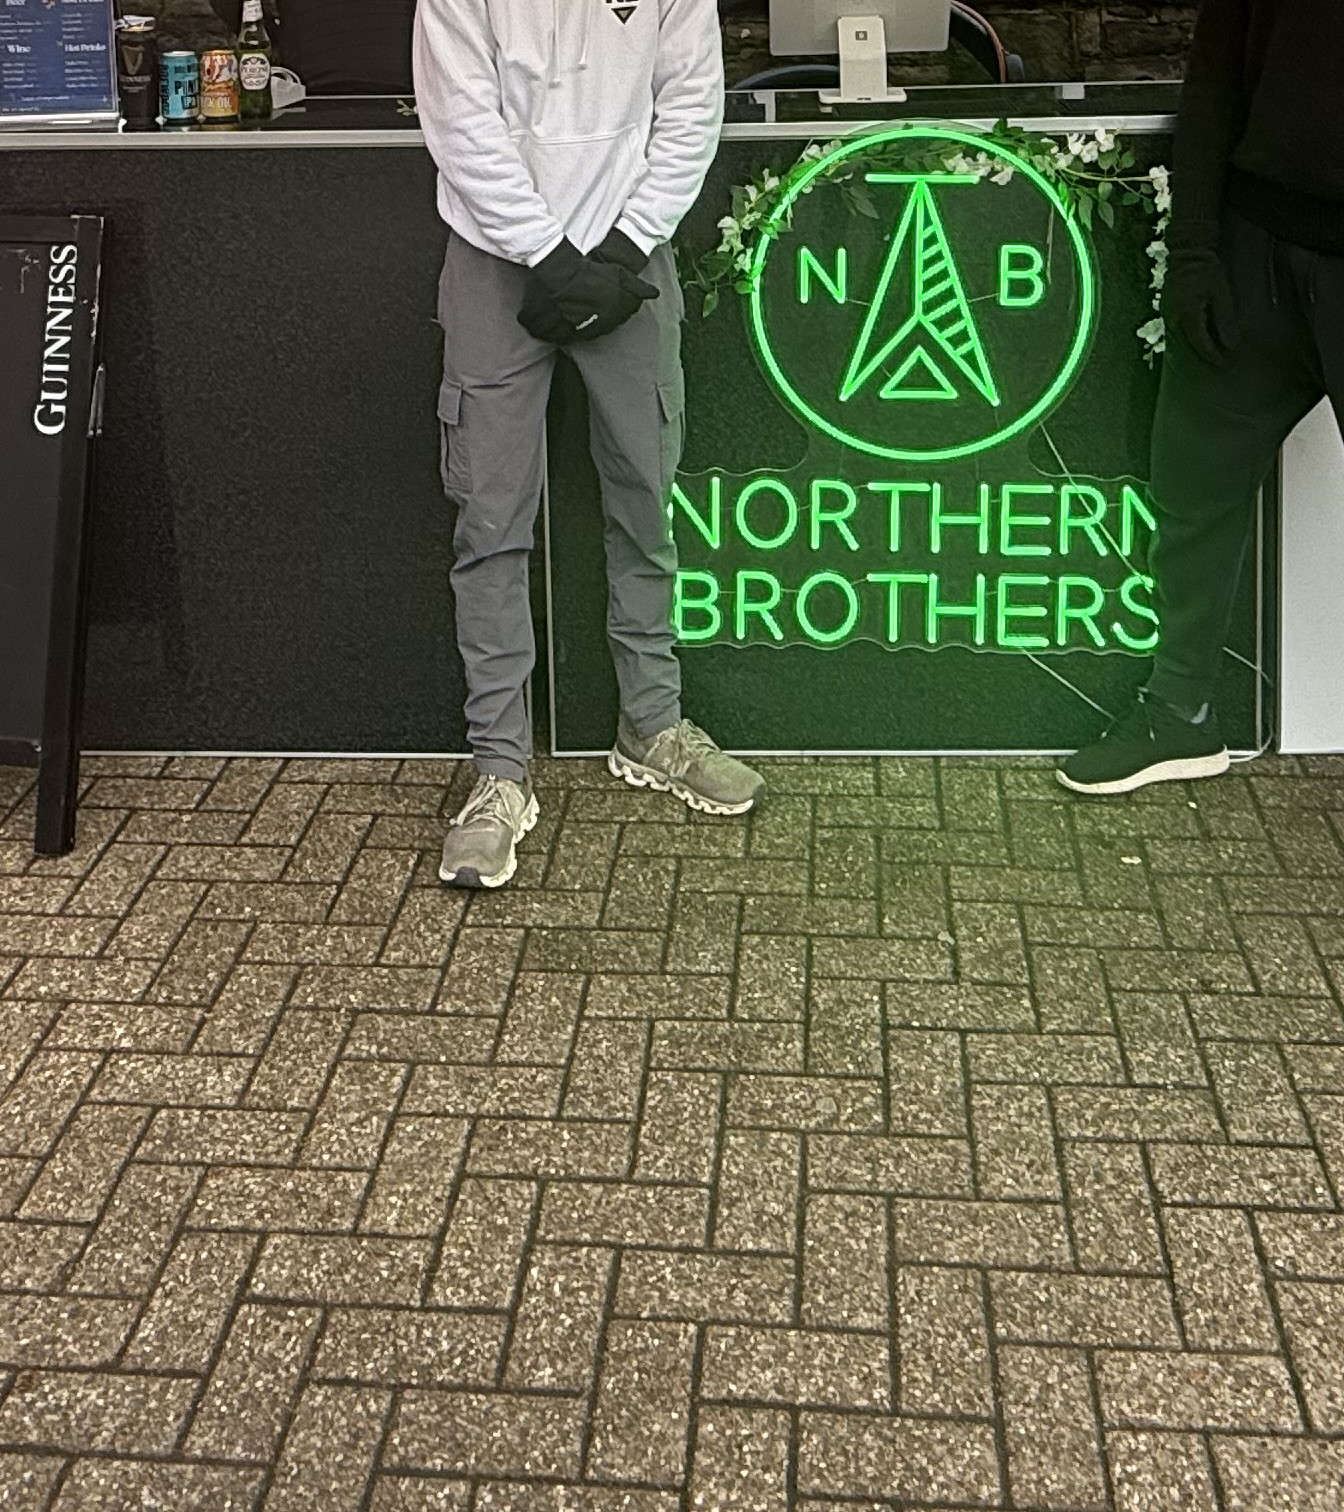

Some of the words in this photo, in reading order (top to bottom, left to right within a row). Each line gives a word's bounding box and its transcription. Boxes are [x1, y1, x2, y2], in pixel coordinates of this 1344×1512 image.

[799, 245, 847, 305] N
[998, 243, 1045, 307] B
[33, 243, 78, 436] GUINNESS
[673, 569, 1160, 650] BROTHERS
